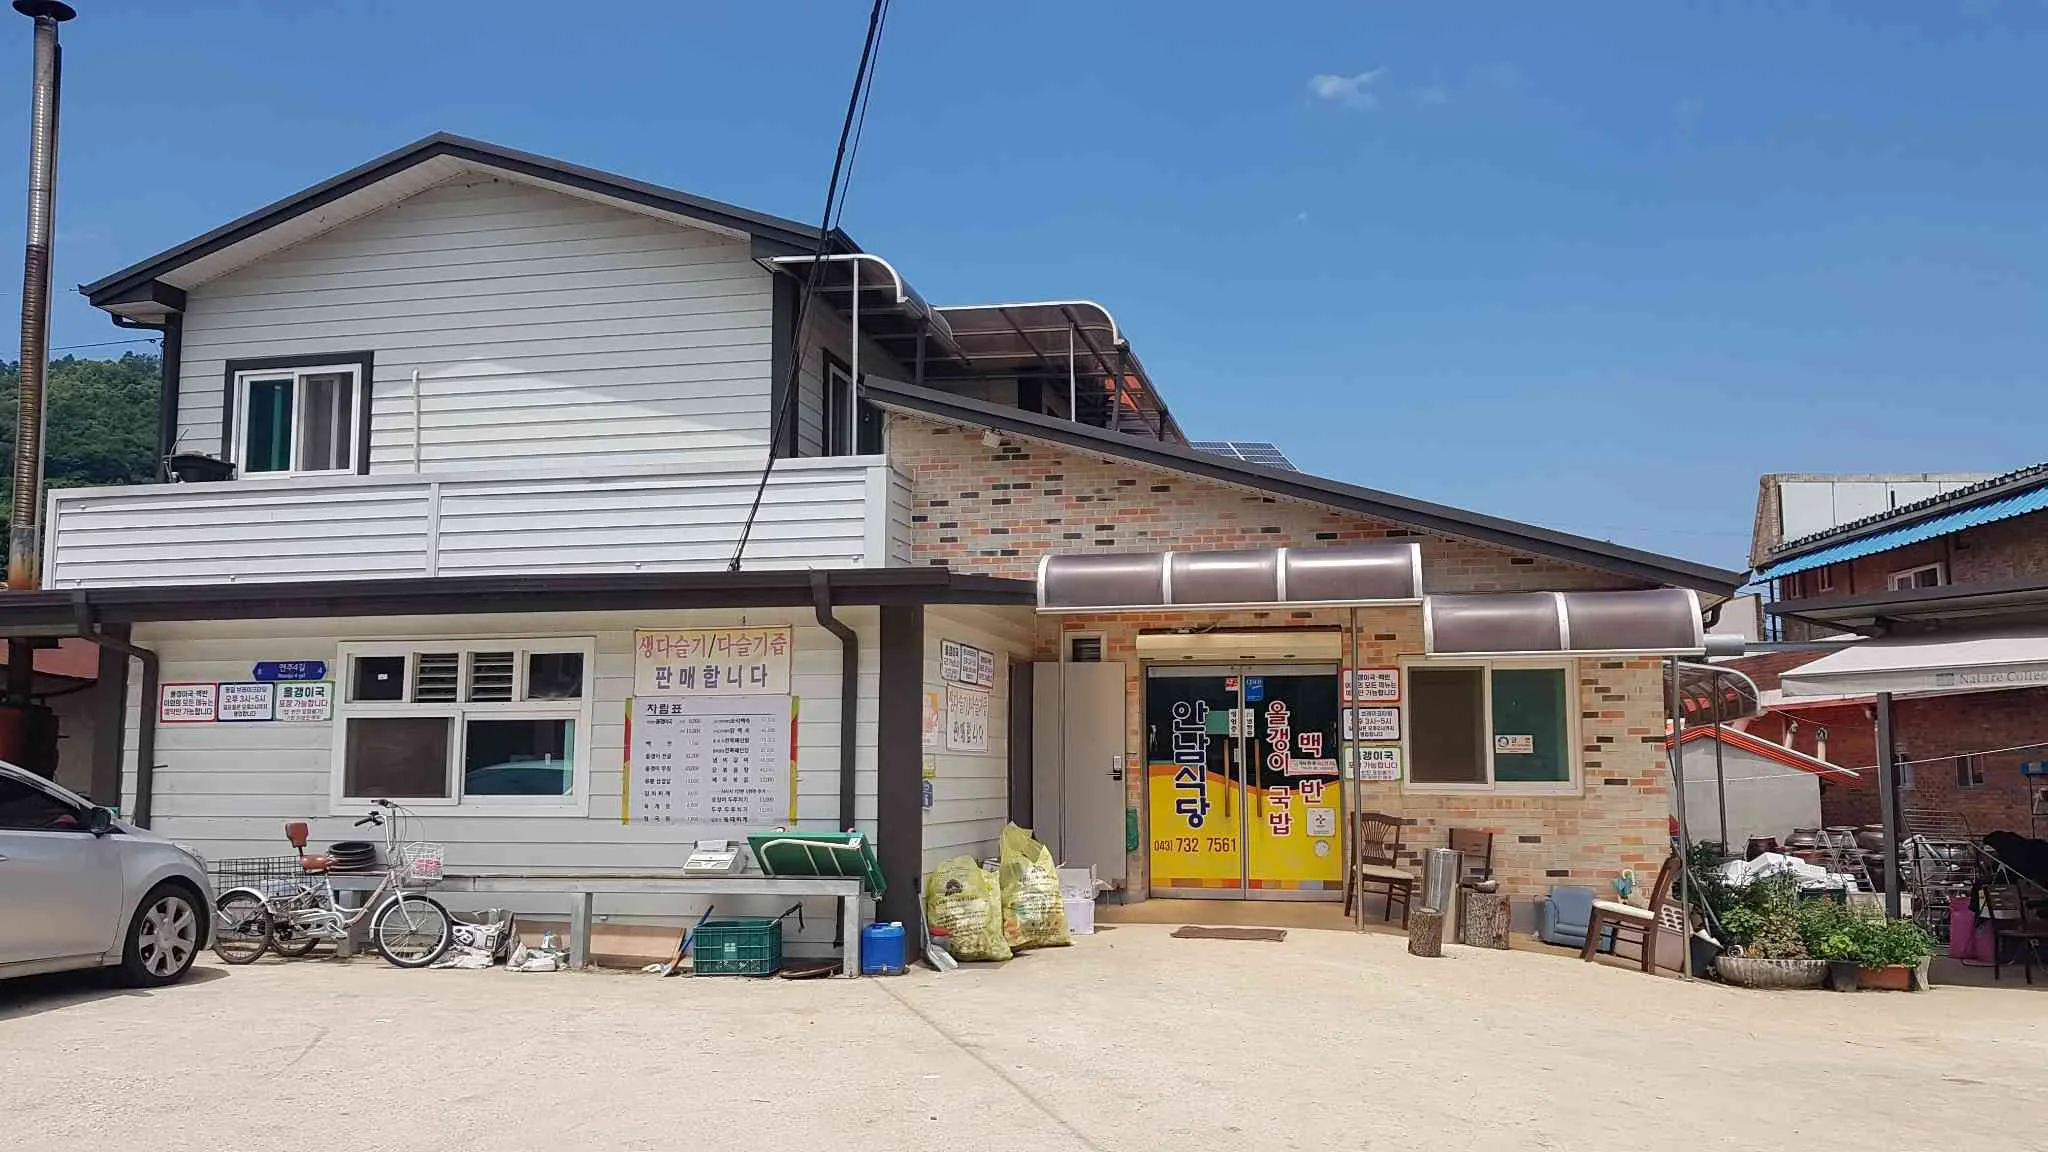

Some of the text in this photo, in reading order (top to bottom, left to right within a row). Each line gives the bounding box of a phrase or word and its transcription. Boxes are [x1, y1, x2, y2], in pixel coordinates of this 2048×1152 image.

[639, 632, 787, 658] 생다슬기/다슬기즙
[283, 686, 325, 698] 올갱이국
[1176, 837, 1199, 853] 732
[1207, 837, 1237, 853] 7561
